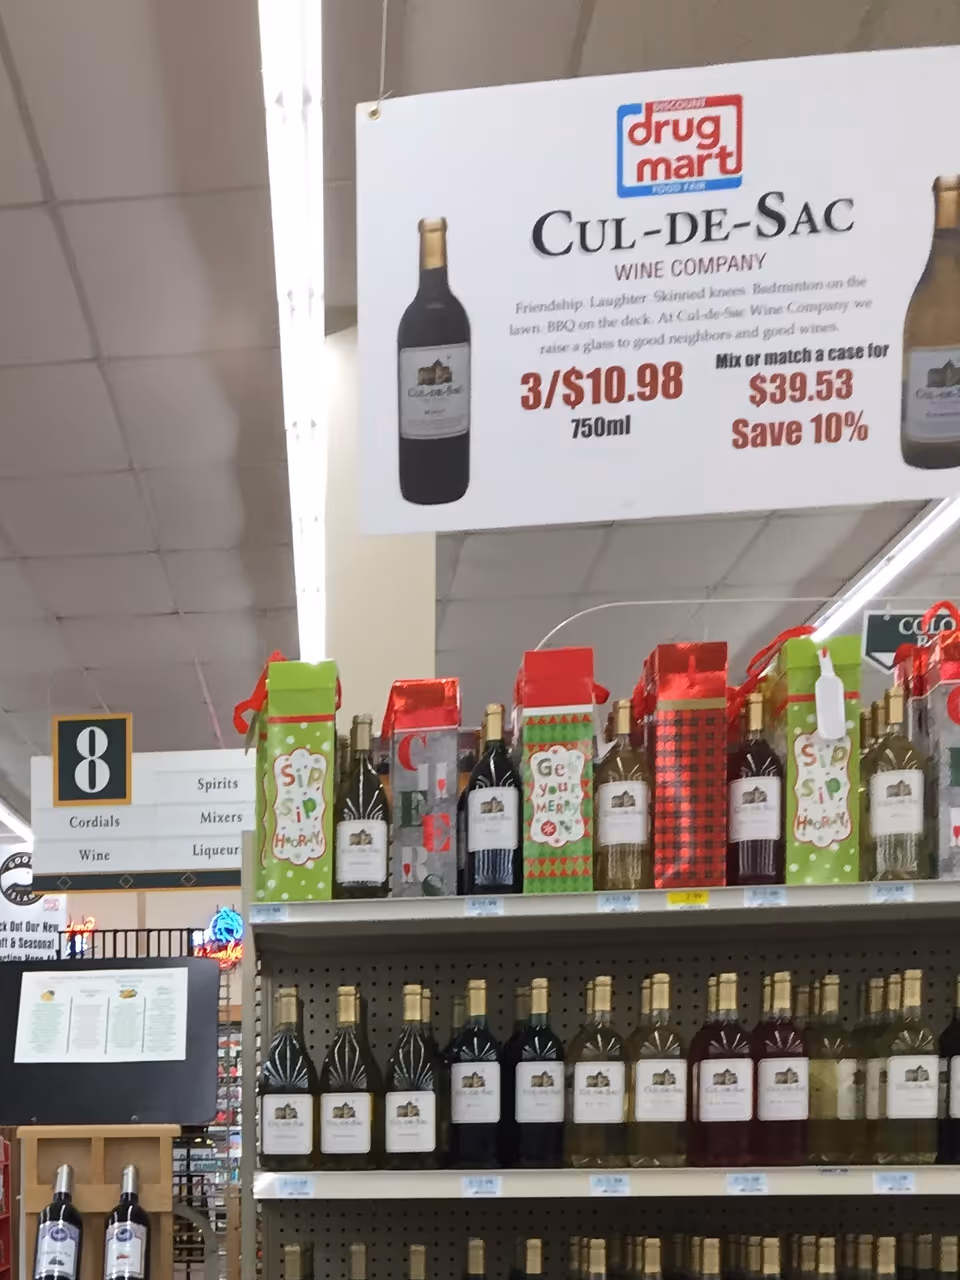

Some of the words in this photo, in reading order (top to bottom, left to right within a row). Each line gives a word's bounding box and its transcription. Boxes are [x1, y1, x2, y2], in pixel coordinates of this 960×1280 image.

[628, 102, 721, 150] drug
[636, 145, 737, 182] mart
[615, 261, 665, 281] WINE
[671, 253, 767, 277] COMPANY
[753, 279, 823, 294] Badminton
[826, 280, 843, 289] on
[847, 275, 867, 288] the
[547, 317, 576, 334] BBQ
[578, 321, 594, 331] on
[598, 316, 618, 329] the
[658, 310, 674, 325] At
[750, 302, 785, 317] Wine
[786, 299, 849, 316] Company
[854, 299, 873, 310] we
[540, 341, 570, 356] raise
[573, 343, 582, 352] a
[583, 338, 615, 354] glass
[617, 336, 630, 348] to
[633, 332, 666, 351] good
[668, 326, 732, 347] neighbors
[734, 325, 759, 340] and
[763, 321, 796, 340] good
[716, 353, 741, 370] Mix
[745, 354, 761, 367] or
[764, 348, 812, 366] match
[815, 351, 824, 363] a
[828, 347, 864, 362] case
[867, 343, 890, 358] for
[520, 361, 683, 411] 3/$10.98
[749, 368, 854, 407] $39.53
[571, 415, 631, 439] 750ml
[732, 417, 803, 449] Save
[810, 410, 869, 443] 10%
[74, 726, 111, 793] 8
[197, 777, 239, 793] Spirits
[69, 815, 120, 828] Cordials
[200, 812, 243, 824] Mixers
[79, 849, 110, 861] Wine
[193, 844, 242, 860] Liqueur
[10, 921, 23, 932] Out
[25, 921, 40, 932] Our
[43, 922, 59, 932] New
[10, 938, 16, 949] &
[18, 937, 54, 949] Seasonal
